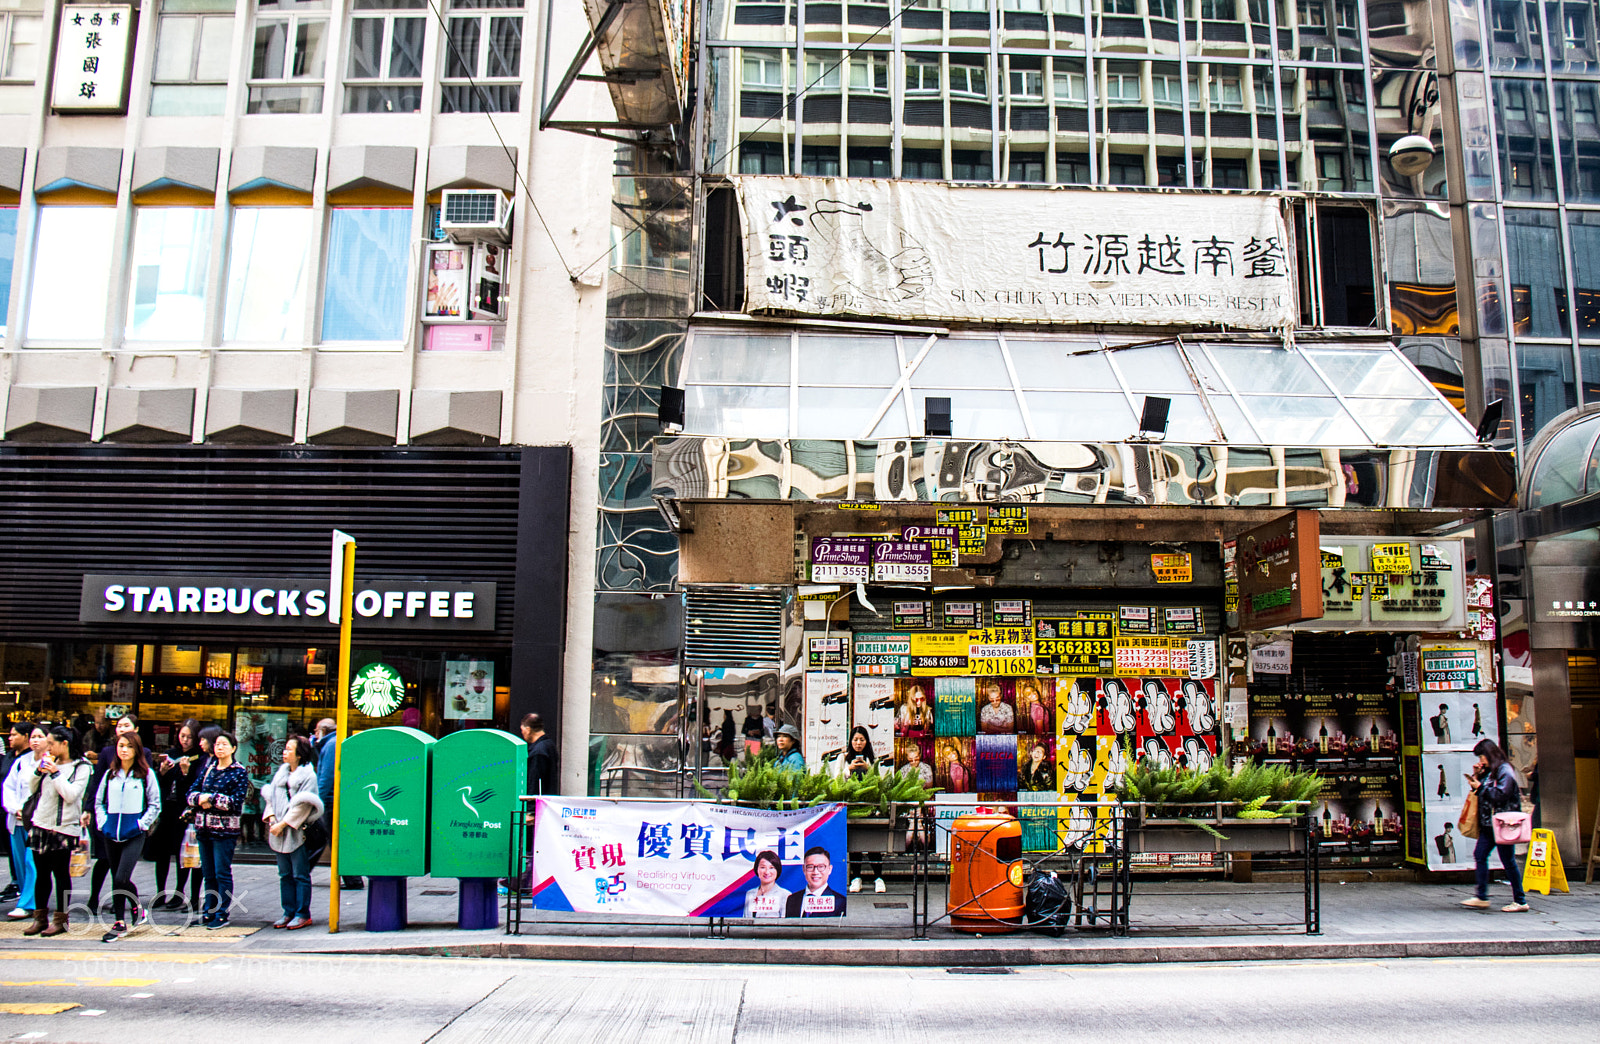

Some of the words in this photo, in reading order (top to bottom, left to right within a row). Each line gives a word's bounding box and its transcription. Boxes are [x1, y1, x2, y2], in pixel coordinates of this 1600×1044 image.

[766, 195, 809, 302] 大頭蝦
[950, 289, 986, 302] SUN
[994, 290, 1043, 305] CHUK
[1052, 291, 1102, 306] YUEN
[1108, 293, 1218, 309] VIETNAMESE
[815, 567, 838, 576] 2111
[843, 567, 867, 577] 3555
[877, 565, 901, 574] 2111
[905, 566, 929, 575] 3555
[104, 585, 326, 616] STARBUCKS
[353, 589, 474, 618] OFFEE
[980, 629, 1033, 644] 永昇物業
[1038, 641, 1110, 654] 23662833
[856, 656, 877, 664] 2928
[879, 655, 899, 664] 6333
[919, 657, 937, 666] 2868
[940, 657, 958, 666] 6189
[971, 658, 1033, 674] 27811682
[1255, 662, 1271, 670] 9375
[1426, 673, 1445, 681] 2928
[1447, 672, 1466, 680] 6333
[938, 695, 972, 703] FELICIA
[980, 752, 1014, 760] FELICIA
[1021, 808, 1056, 817] FELICIA
[357, 817, 391, 826] Hongkong
[390, 818, 408, 826] Post
[450, 820, 483, 829] Hongkong
[483, 821, 501, 829] Post
[636, 821, 801, 863] 優質民主
[571, 843, 626, 872] 實現
[637, 870, 679, 881] Realising
[681, 870, 716, 881] Virtuous
[637, 880, 693, 892] Democracy
